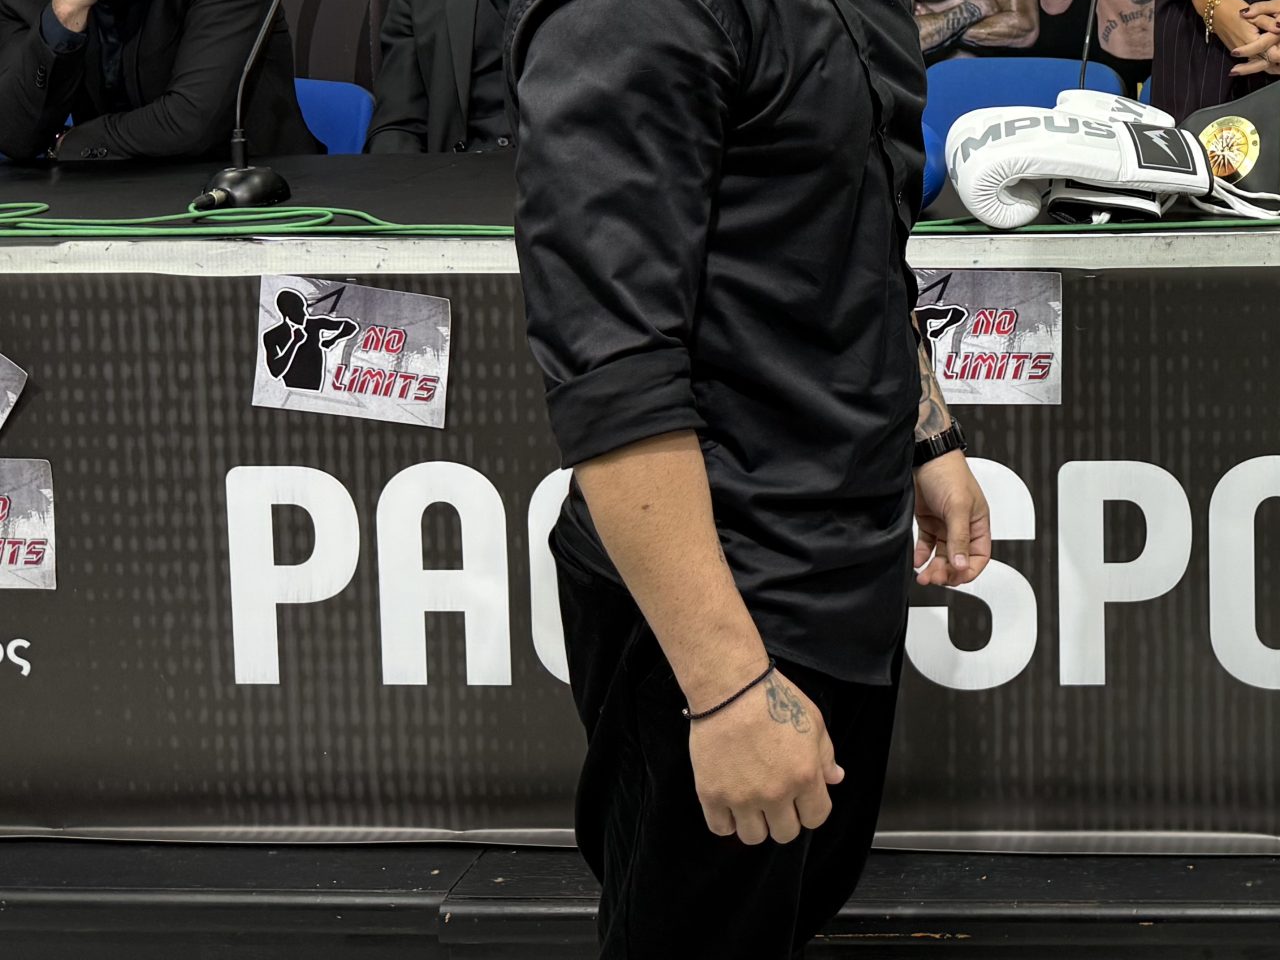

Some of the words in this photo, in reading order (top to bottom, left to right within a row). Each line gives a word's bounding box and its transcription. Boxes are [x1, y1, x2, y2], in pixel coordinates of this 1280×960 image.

[970, 307, 1019, 337] NO
[360, 324, 408, 355] NO
[942, 349, 1055, 381] LIMITS
[331, 363, 441, 403] LIMITS
